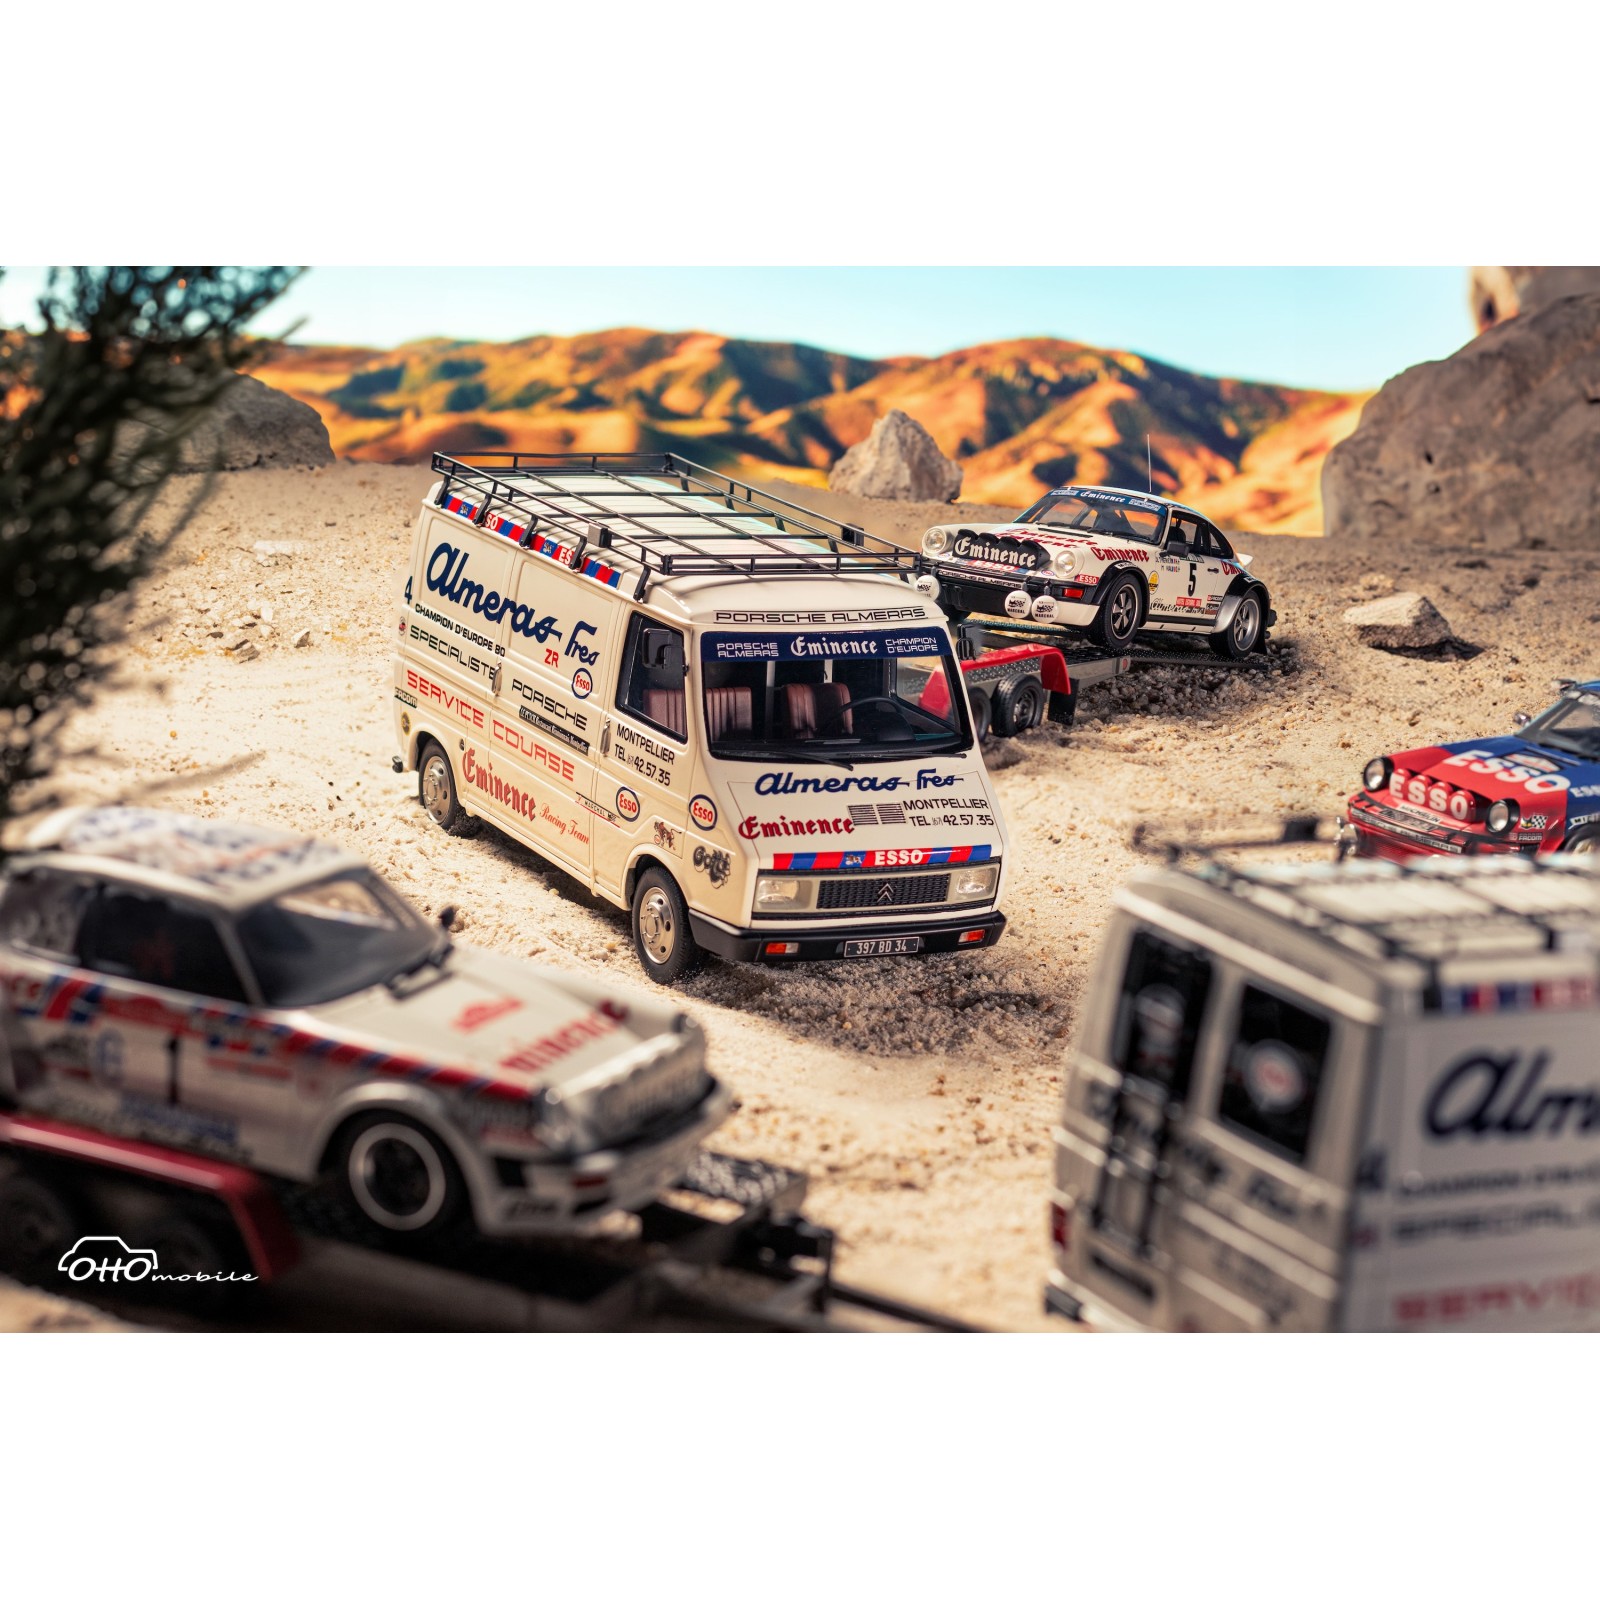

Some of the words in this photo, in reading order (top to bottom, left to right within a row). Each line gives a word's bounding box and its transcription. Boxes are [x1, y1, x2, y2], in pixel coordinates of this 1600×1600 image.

[955, 536, 1037, 567] Eminence
[1090, 547, 1150, 562] Eminence
[1079, 575, 1097, 584] ESSO
[1188, 563, 1197, 597] 5
[716, 612, 827, 623] PORSCHE
[832, 608, 927, 622] ALMERAS
[415, 603, 454, 631] CHAMPION
[455, 624, 493, 652] D'EUROPE
[565, 620, 601, 667] Fres
[716, 642, 778, 650] PORSCHE
[790, 636, 878, 657] Eminence
[885, 637, 937, 646] CHAMPION
[887, 645, 939, 653] D'EUROPE
[544, 649, 559, 668] ZR
[717, 650, 779, 658] ALMERAS
[511, 679, 588, 731] PORSCHE
[407, 669, 485, 729] SERVICE
[492, 719, 576, 783] COURSE
[617, 723, 675, 765] MONTPELLIER
[916, 768, 964, 789] Fres
[1442, 749, 1572, 795] ESSO
[462, 747, 537, 822] Eminence
[539, 802, 568, 835] Racing
[568, 819, 590, 845] Team
[903, 798, 989, 811] MONTPELLIER
[1388, 774, 1468, 820] ESSO
[738, 815, 855, 840] Eminence
[909, 815, 931, 827] TEL
[873, 849, 924, 866] ESSO
[856, 941, 875, 955] 397
[878, 940, 893, 953] BD
[895, 939, 907, 952] 34
